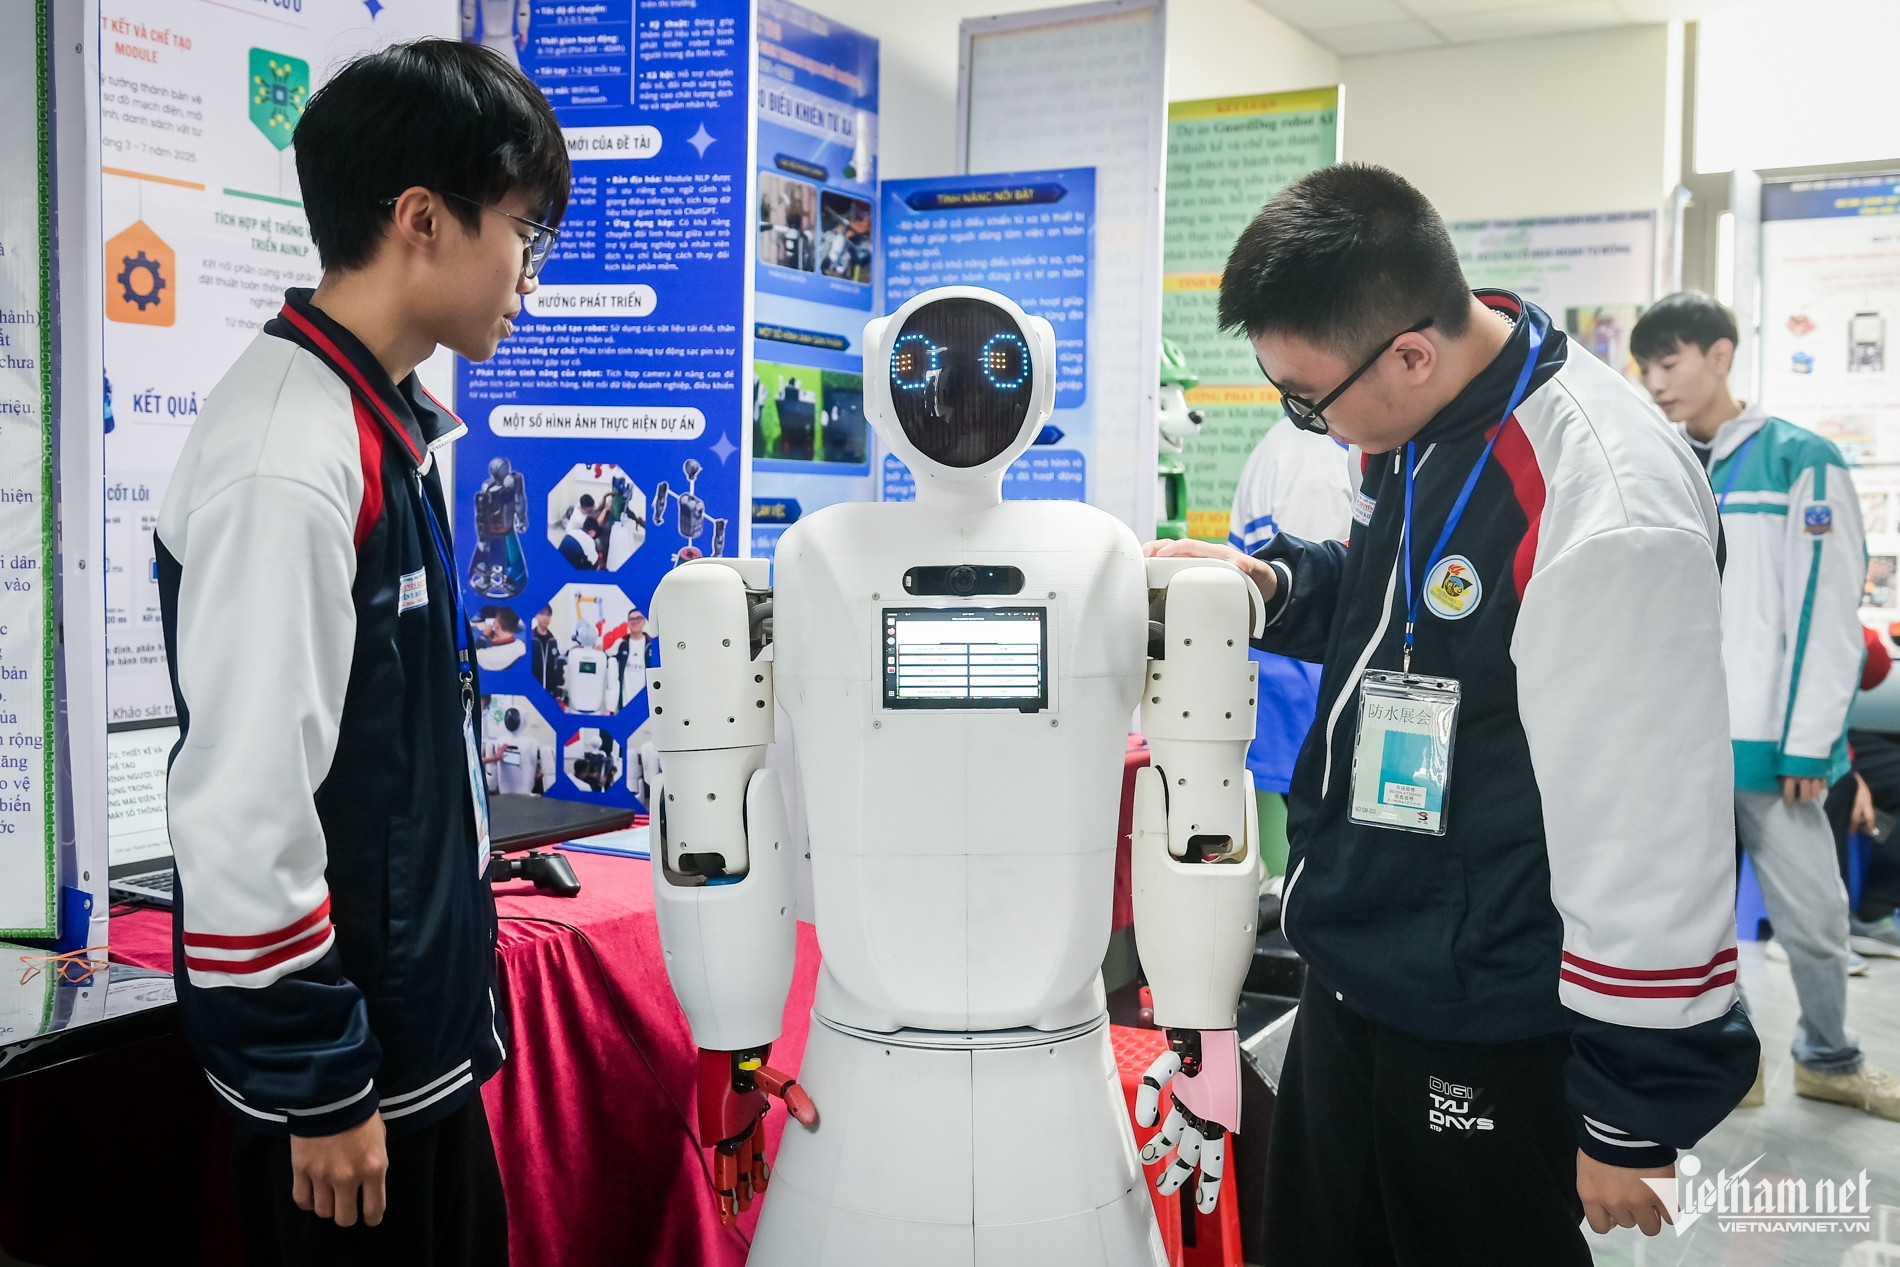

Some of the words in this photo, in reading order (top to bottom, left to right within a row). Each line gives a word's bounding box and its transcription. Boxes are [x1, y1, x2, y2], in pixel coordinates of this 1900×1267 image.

[111, 17, 131, 36] KẾT
[134, 22, 148, 40] VÀ
[151, 26, 171, 47] CHẾ
[173, 33, 193, 52] TẠO
[115, 42, 158, 64] MODULE
[140, 83, 169, 95] thành
[132, 98, 160, 110] mạch
[571, 95, 607, 103] Bluetooth
[124, 139, 131, 150] 3
[141, 142, 147, 152] 7
[173, 149, 196, 162] 2025
[567, 138, 588, 150] MỚI
[592, 135, 613, 149] CỦA
[616, 135, 629, 149] ĐỀ
[634, 137, 650, 148] TÀI
[683, 206, 718, 214] ChatGPT.
[214, 210, 235, 227] TÍCH
[274, 219, 304, 238] THỐNG
[538, 296, 576, 307] HƯỚNG
[579, 296, 606, 306] PHÁT
[611, 292, 641, 307] TRIỂN
[577, 369, 602, 377] robot:
[133, 387, 162, 413] KẾT
[167, 392, 199, 418] QUẢ
[503, 413, 524, 426] MỘT
[529, 413, 542, 427] SỐ
[545, 417, 571, 427] HÌNH
[574, 413, 596, 427] ẢNH
[601, 417, 628, 428] THỰC
[632, 414, 657, 429] HIỆN
[661, 418, 676, 432] DỰ
[679, 415, 694, 429] ÁN
[1, 488, 33, 504] hiện
[107, 484, 128, 501] CỐT
[132, 485, 150, 502] LÕI
[10, 555, 41, 569] dân.
[4, 577, 31, 592] vào
[1, 666, 28, 680] bản
[113, 705, 142, 720] Khảo
[145, 704, 162, 717] sát
[1368, 703, 1432, 726] 防水展会
[9, 732, 43, 751] rộng
[0, 756, 28, 773] ăng
[13, 776, 31, 792] vệ
[1429, 1075, 1473, 1100] DIGI
